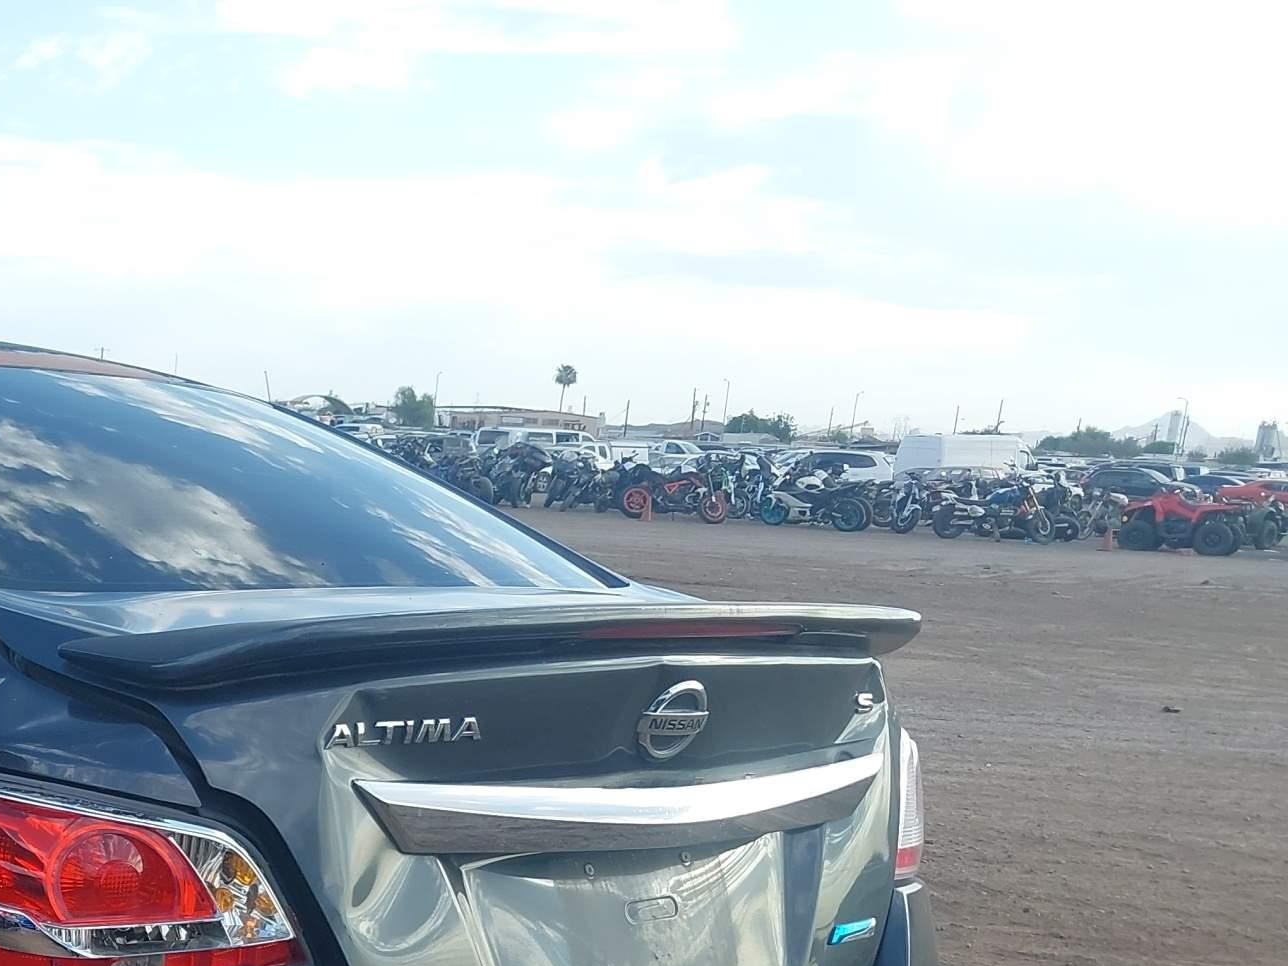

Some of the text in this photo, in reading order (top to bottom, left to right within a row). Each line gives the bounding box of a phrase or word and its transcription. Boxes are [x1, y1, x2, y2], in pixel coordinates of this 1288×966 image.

[856, 692, 874, 714] S
[324, 716, 482, 750] ALTIMA
[648, 717, 704, 731] NISSAN
